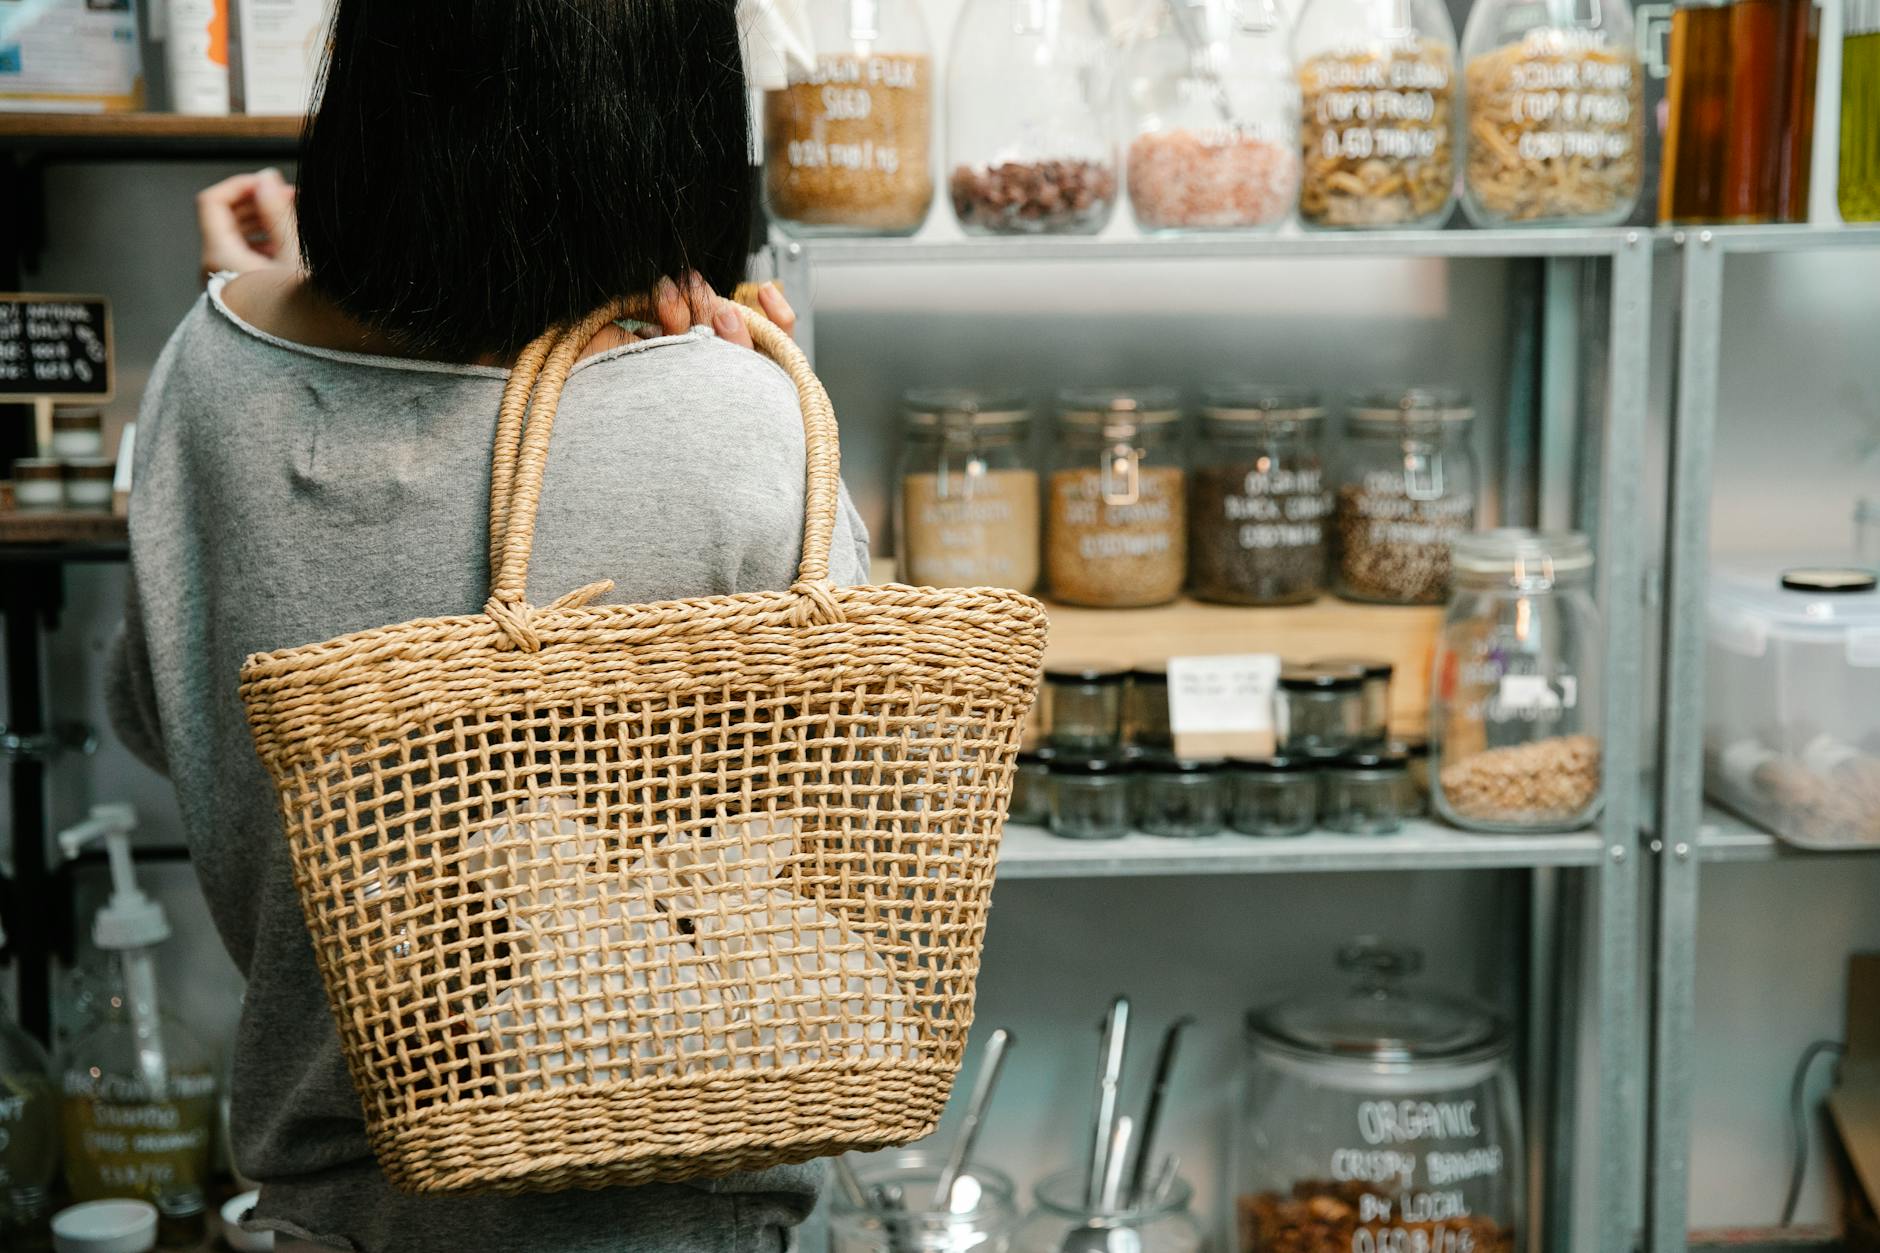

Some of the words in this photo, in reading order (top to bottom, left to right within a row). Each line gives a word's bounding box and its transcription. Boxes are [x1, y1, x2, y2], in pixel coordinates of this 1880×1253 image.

[1357, 1099, 1479, 1144] ORGANIC
[1330, 1148, 1416, 1188] CRISPY
[1400, 1190, 1471, 1223] LOCAL
